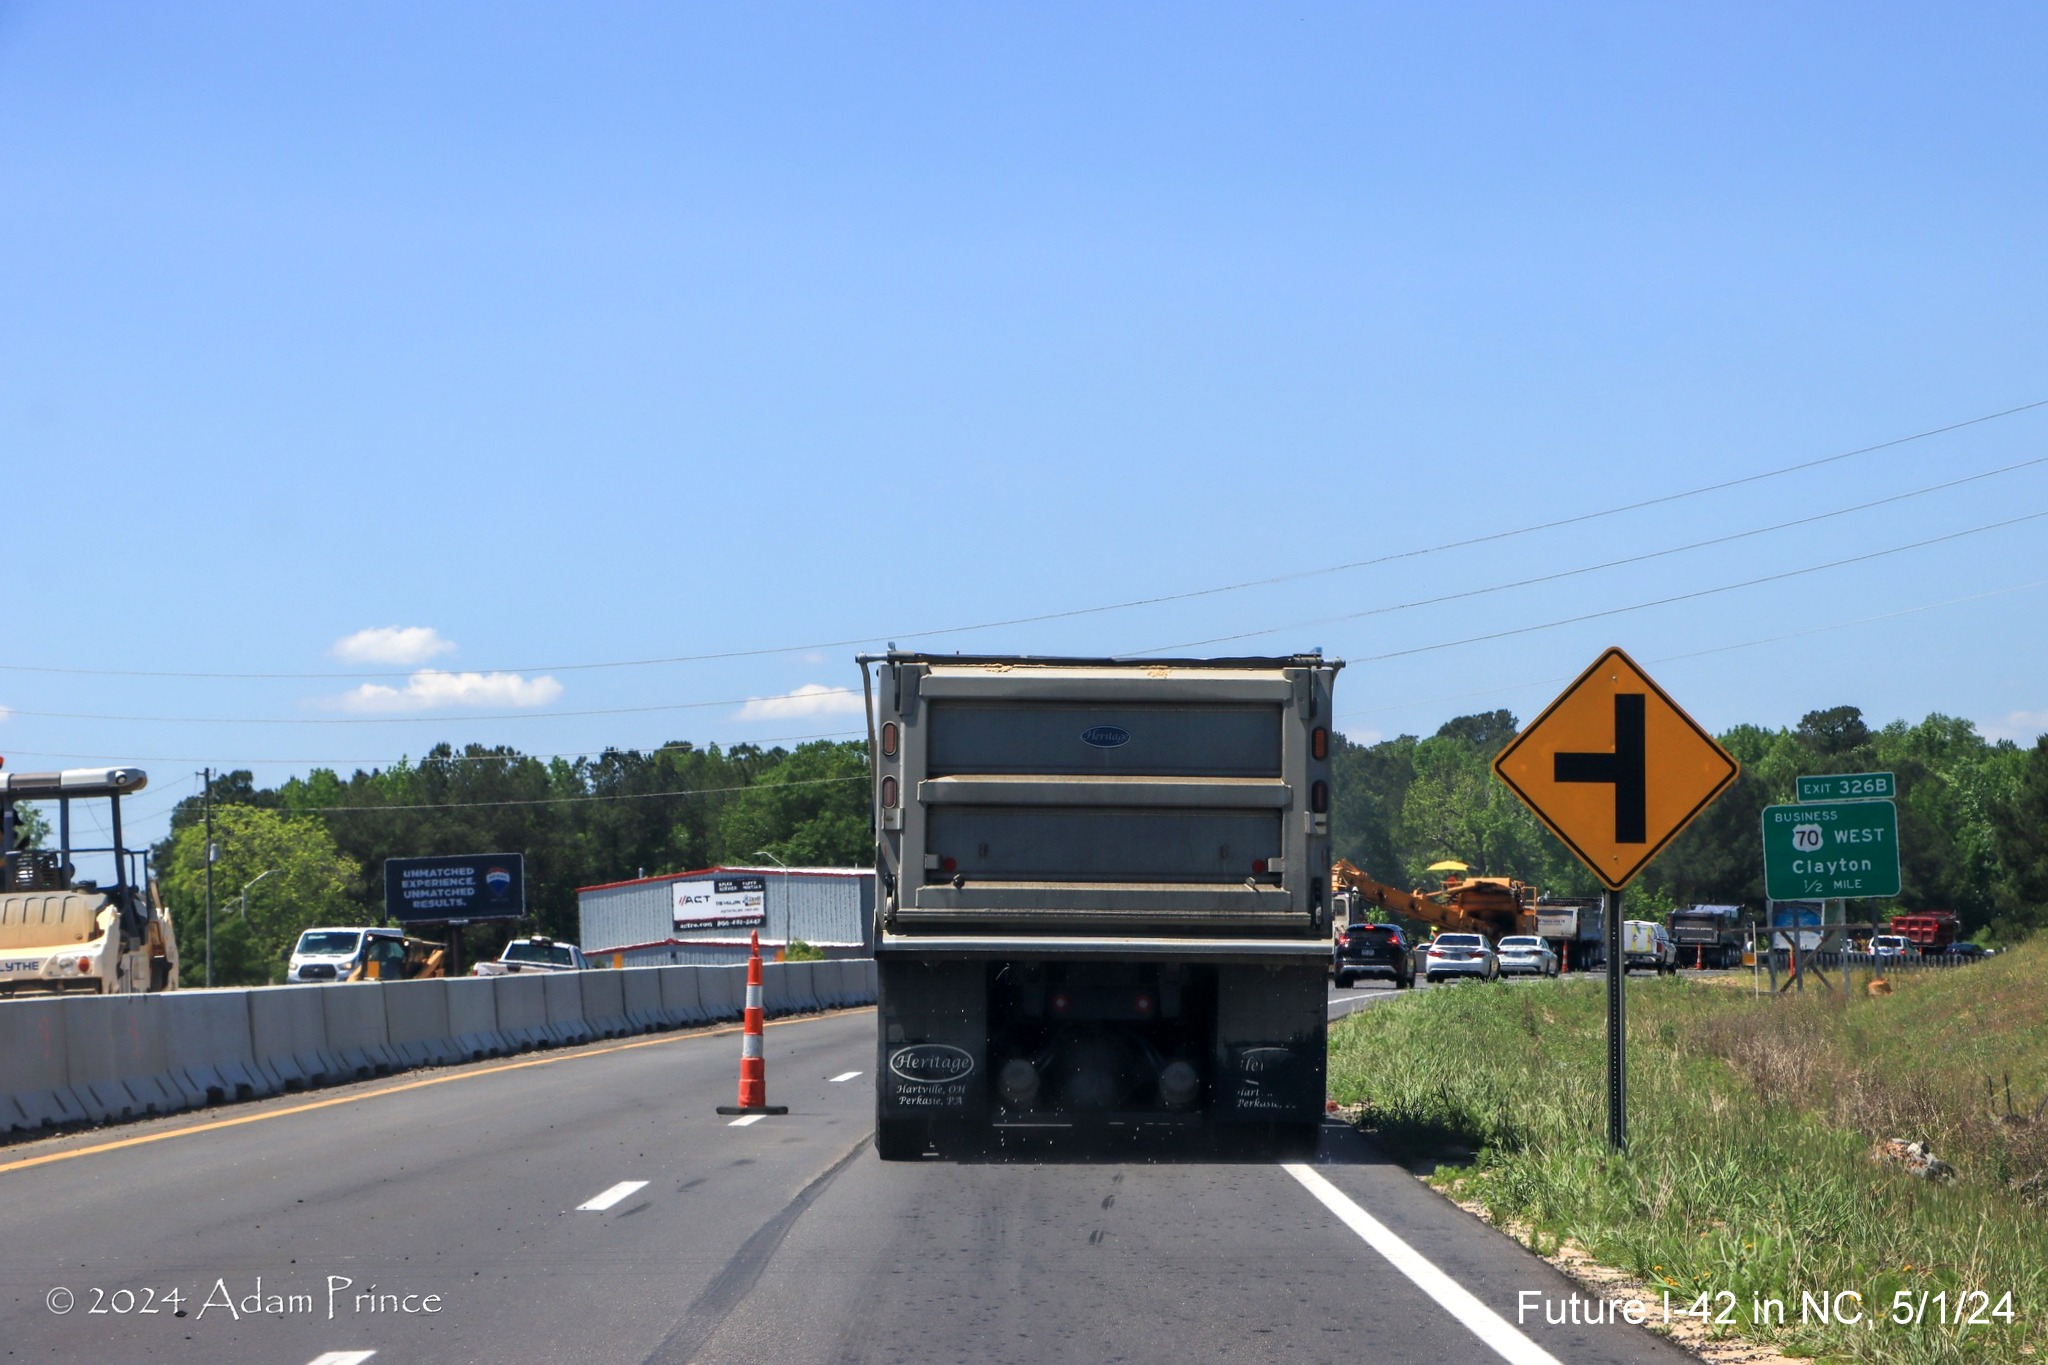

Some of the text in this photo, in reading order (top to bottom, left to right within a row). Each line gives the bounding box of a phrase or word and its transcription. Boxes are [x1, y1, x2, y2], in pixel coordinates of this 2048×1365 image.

[1804, 778, 1887, 794] EXIT 326B
[1775, 811, 1838, 822] BUSINESS
[1795, 828, 1884, 847] 70 WEST
[402, 867, 475, 878] UNMATCHED
[1792, 858, 1872, 876] Clayton
[401, 877, 476, 888] EXPERIENCE.
[1803, 879, 1862, 893] 1/2 MILE
[403, 887, 475, 899] UNMATCHED
[412, 898, 467, 908] RESULTS.
[895, 1053, 969, 1073] Heritage
[896, 1084, 966, 1095] Hartville, OH
[898, 1095, 963, 1106] Perkasie, PA
